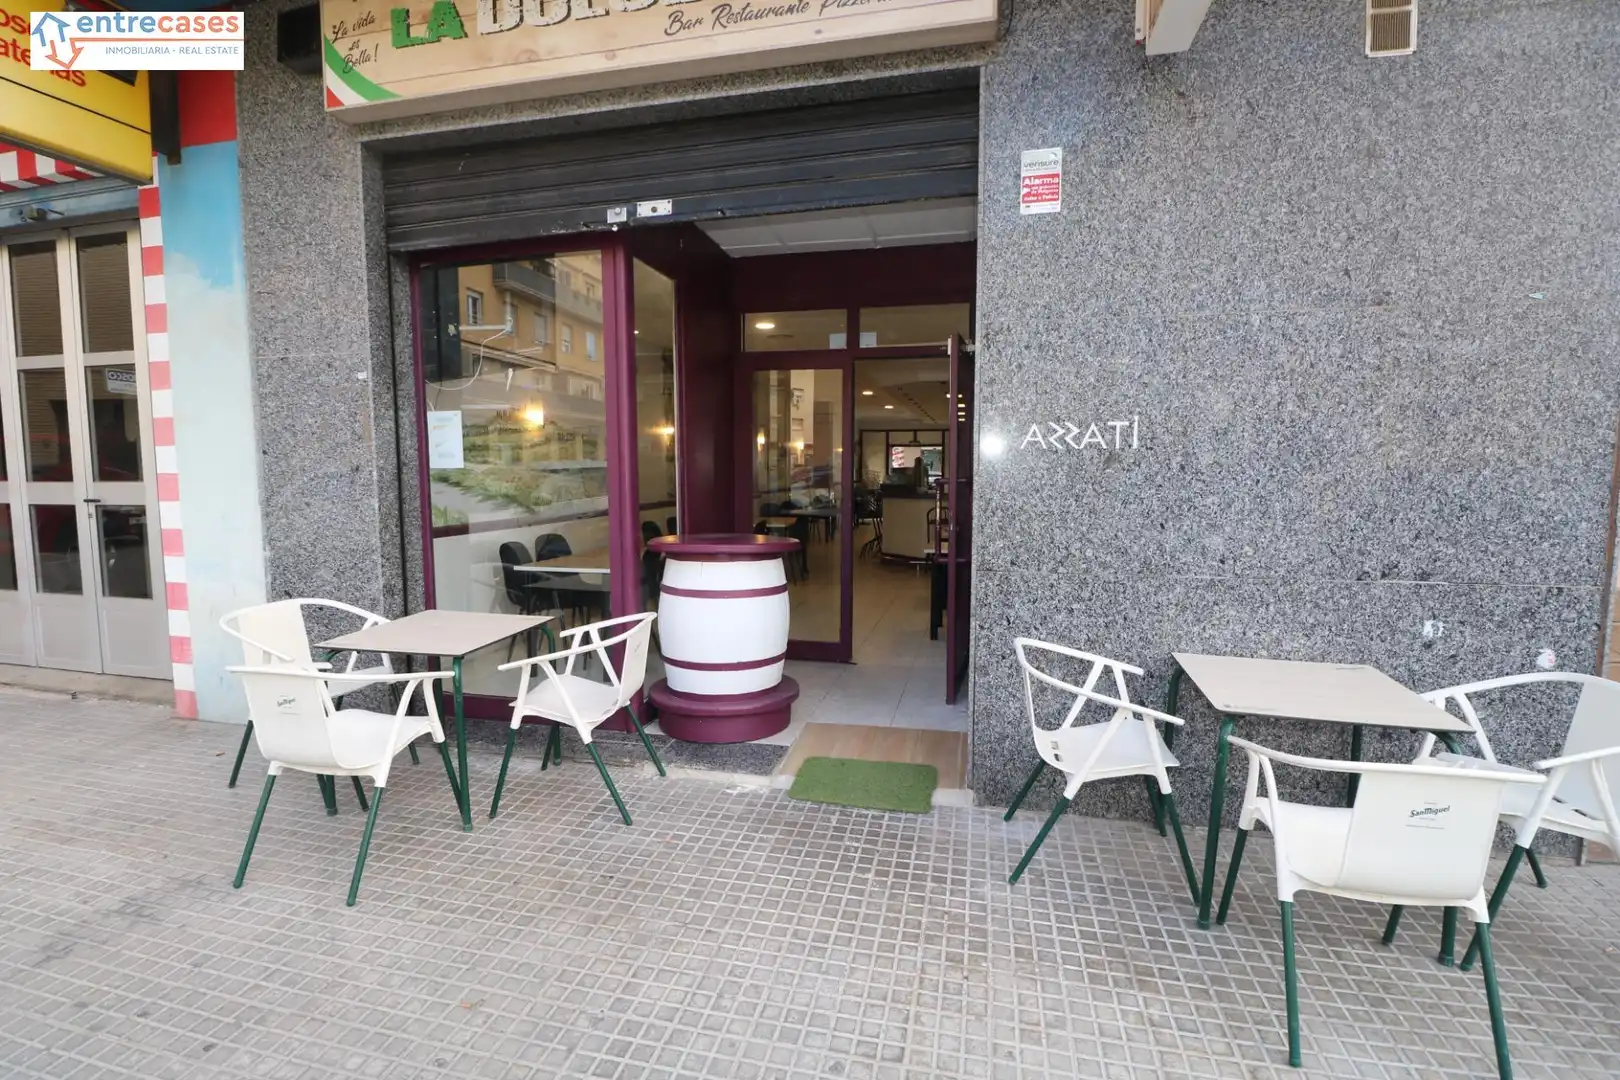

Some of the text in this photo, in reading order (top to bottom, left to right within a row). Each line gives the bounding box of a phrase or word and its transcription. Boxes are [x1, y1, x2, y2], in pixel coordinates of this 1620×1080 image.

[352, 10, 375, 31] vida
[391, 0, 468, 49] LA
[664, 10, 704, 36] Bar
[711, 3, 810, 31] Restaurante
